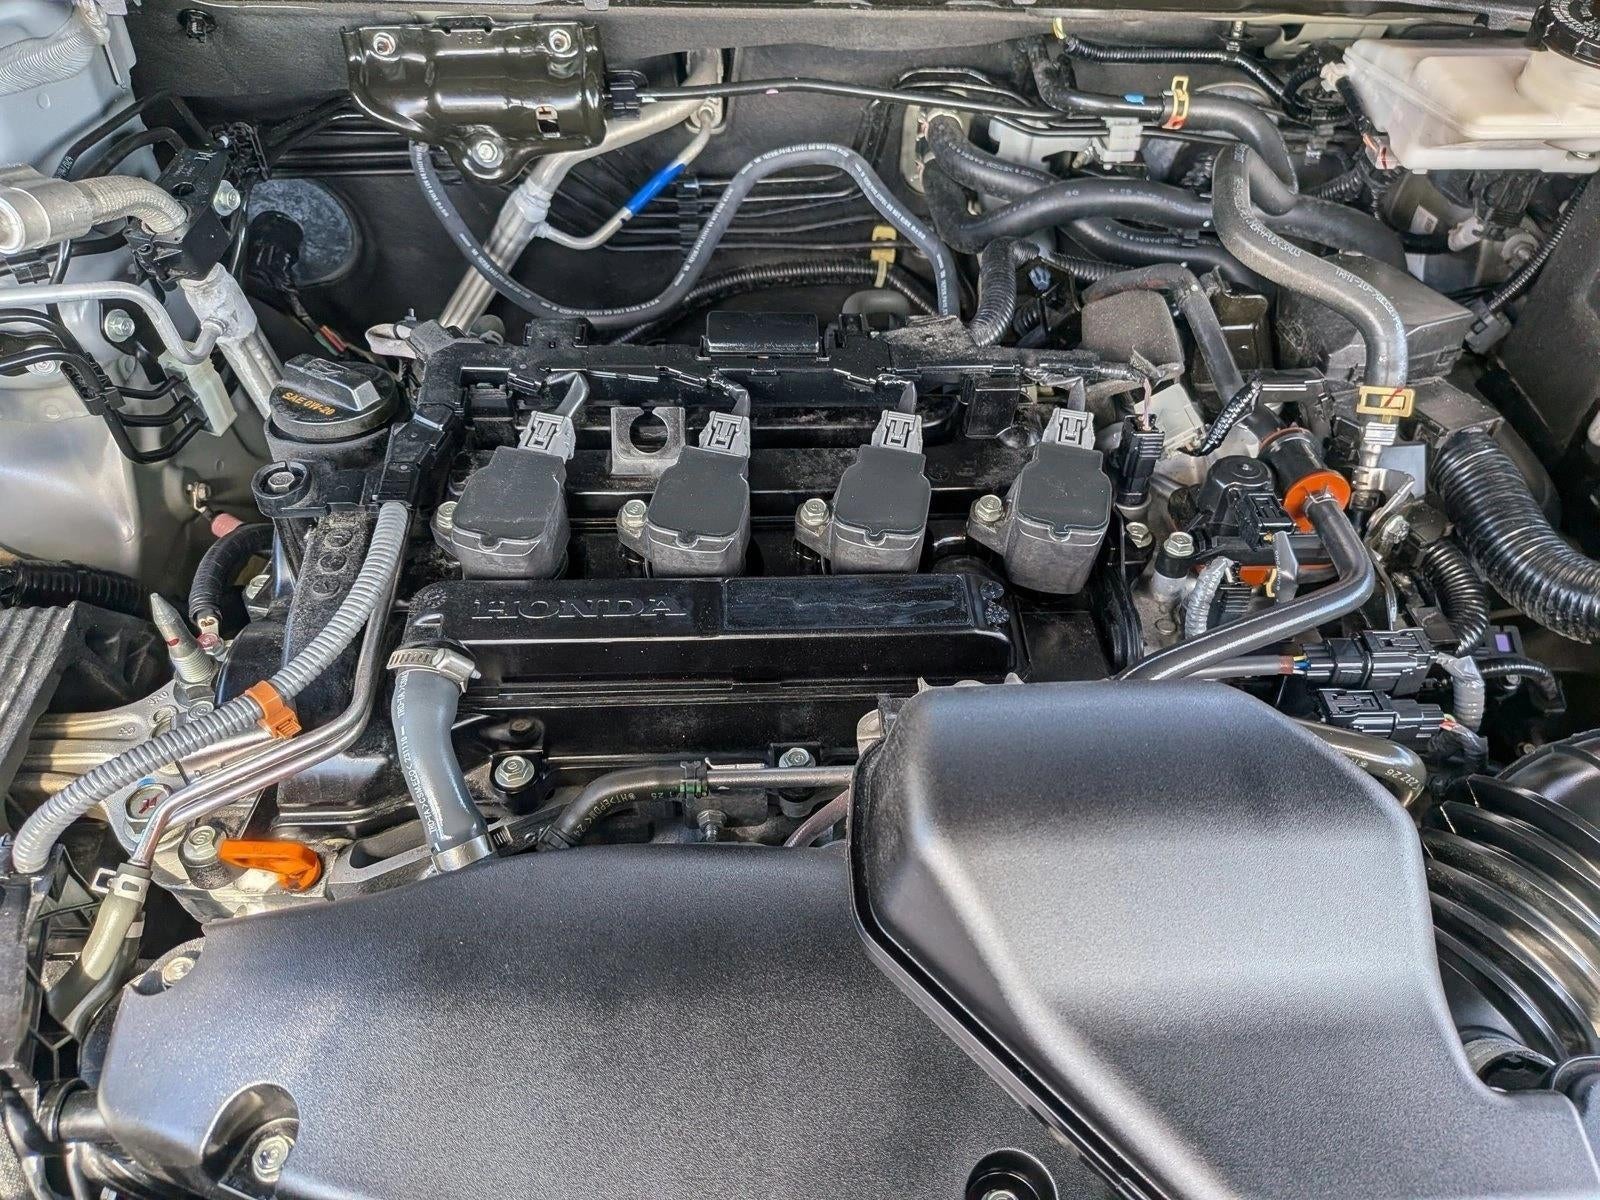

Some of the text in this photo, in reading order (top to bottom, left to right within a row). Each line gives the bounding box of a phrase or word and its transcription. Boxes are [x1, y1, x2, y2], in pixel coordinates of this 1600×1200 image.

[282, 392, 336, 415] SAE 0W-20
[471, 598, 688, 619] HONDA
